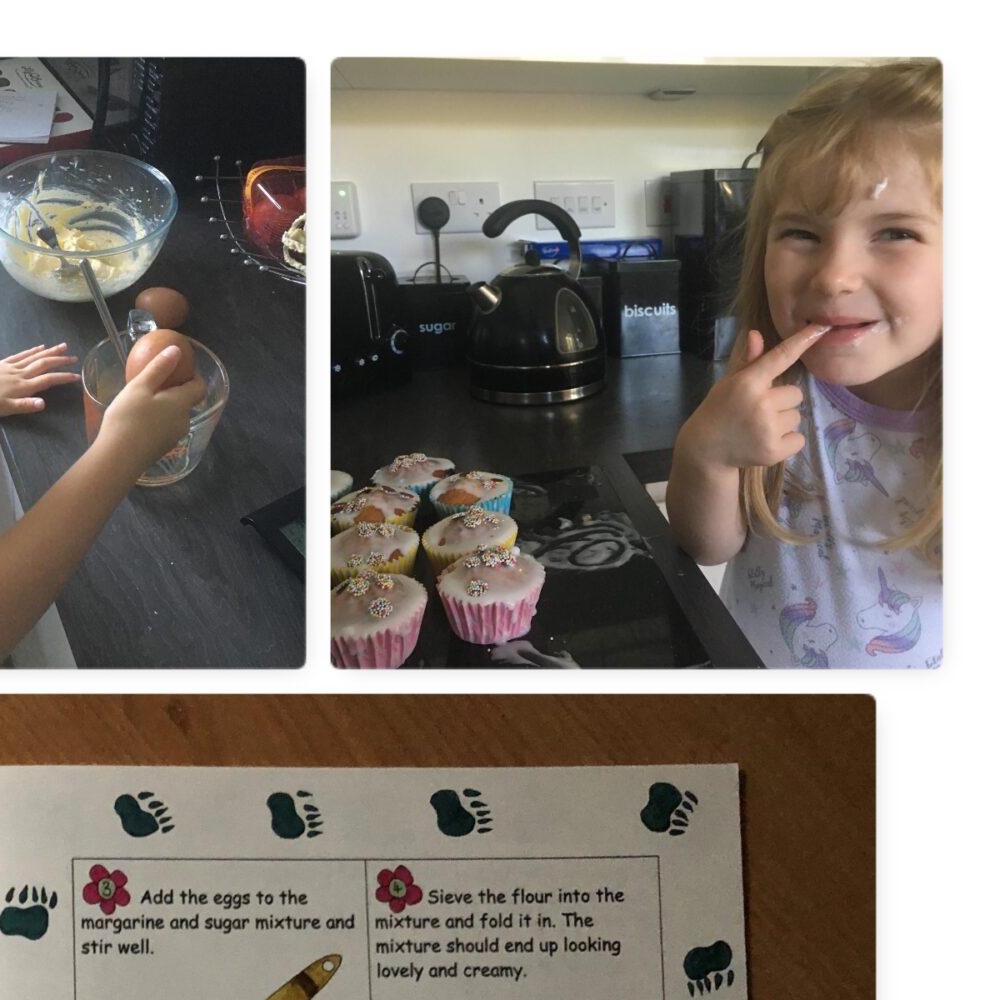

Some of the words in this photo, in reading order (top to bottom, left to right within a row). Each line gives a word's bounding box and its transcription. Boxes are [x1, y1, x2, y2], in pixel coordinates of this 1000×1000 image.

[624, 302, 677, 319] biscuits
[418, 320, 457, 335] sugar
[103, 880, 112, 896] 3
[139, 888, 174, 906] Add
[179, 888, 209, 906] the
[212, 892, 251, 910] eggs
[255, 890, 274, 906] to
[278, 888, 309, 906] the
[393, 880, 403, 894] 4
[427, 888, 474, 905] Sieve
[477, 887, 507, 905] the
[510, 887, 553, 905] flour
[558, 888, 591, 904] into
[595, 886, 625, 904] the
[80, 938, 113, 955] stir
[117, 937, 155, 955] well.
[376, 961, 425, 983] lovely
[428, 961, 458, 979] and
[463, 965, 528, 983] creamy.
